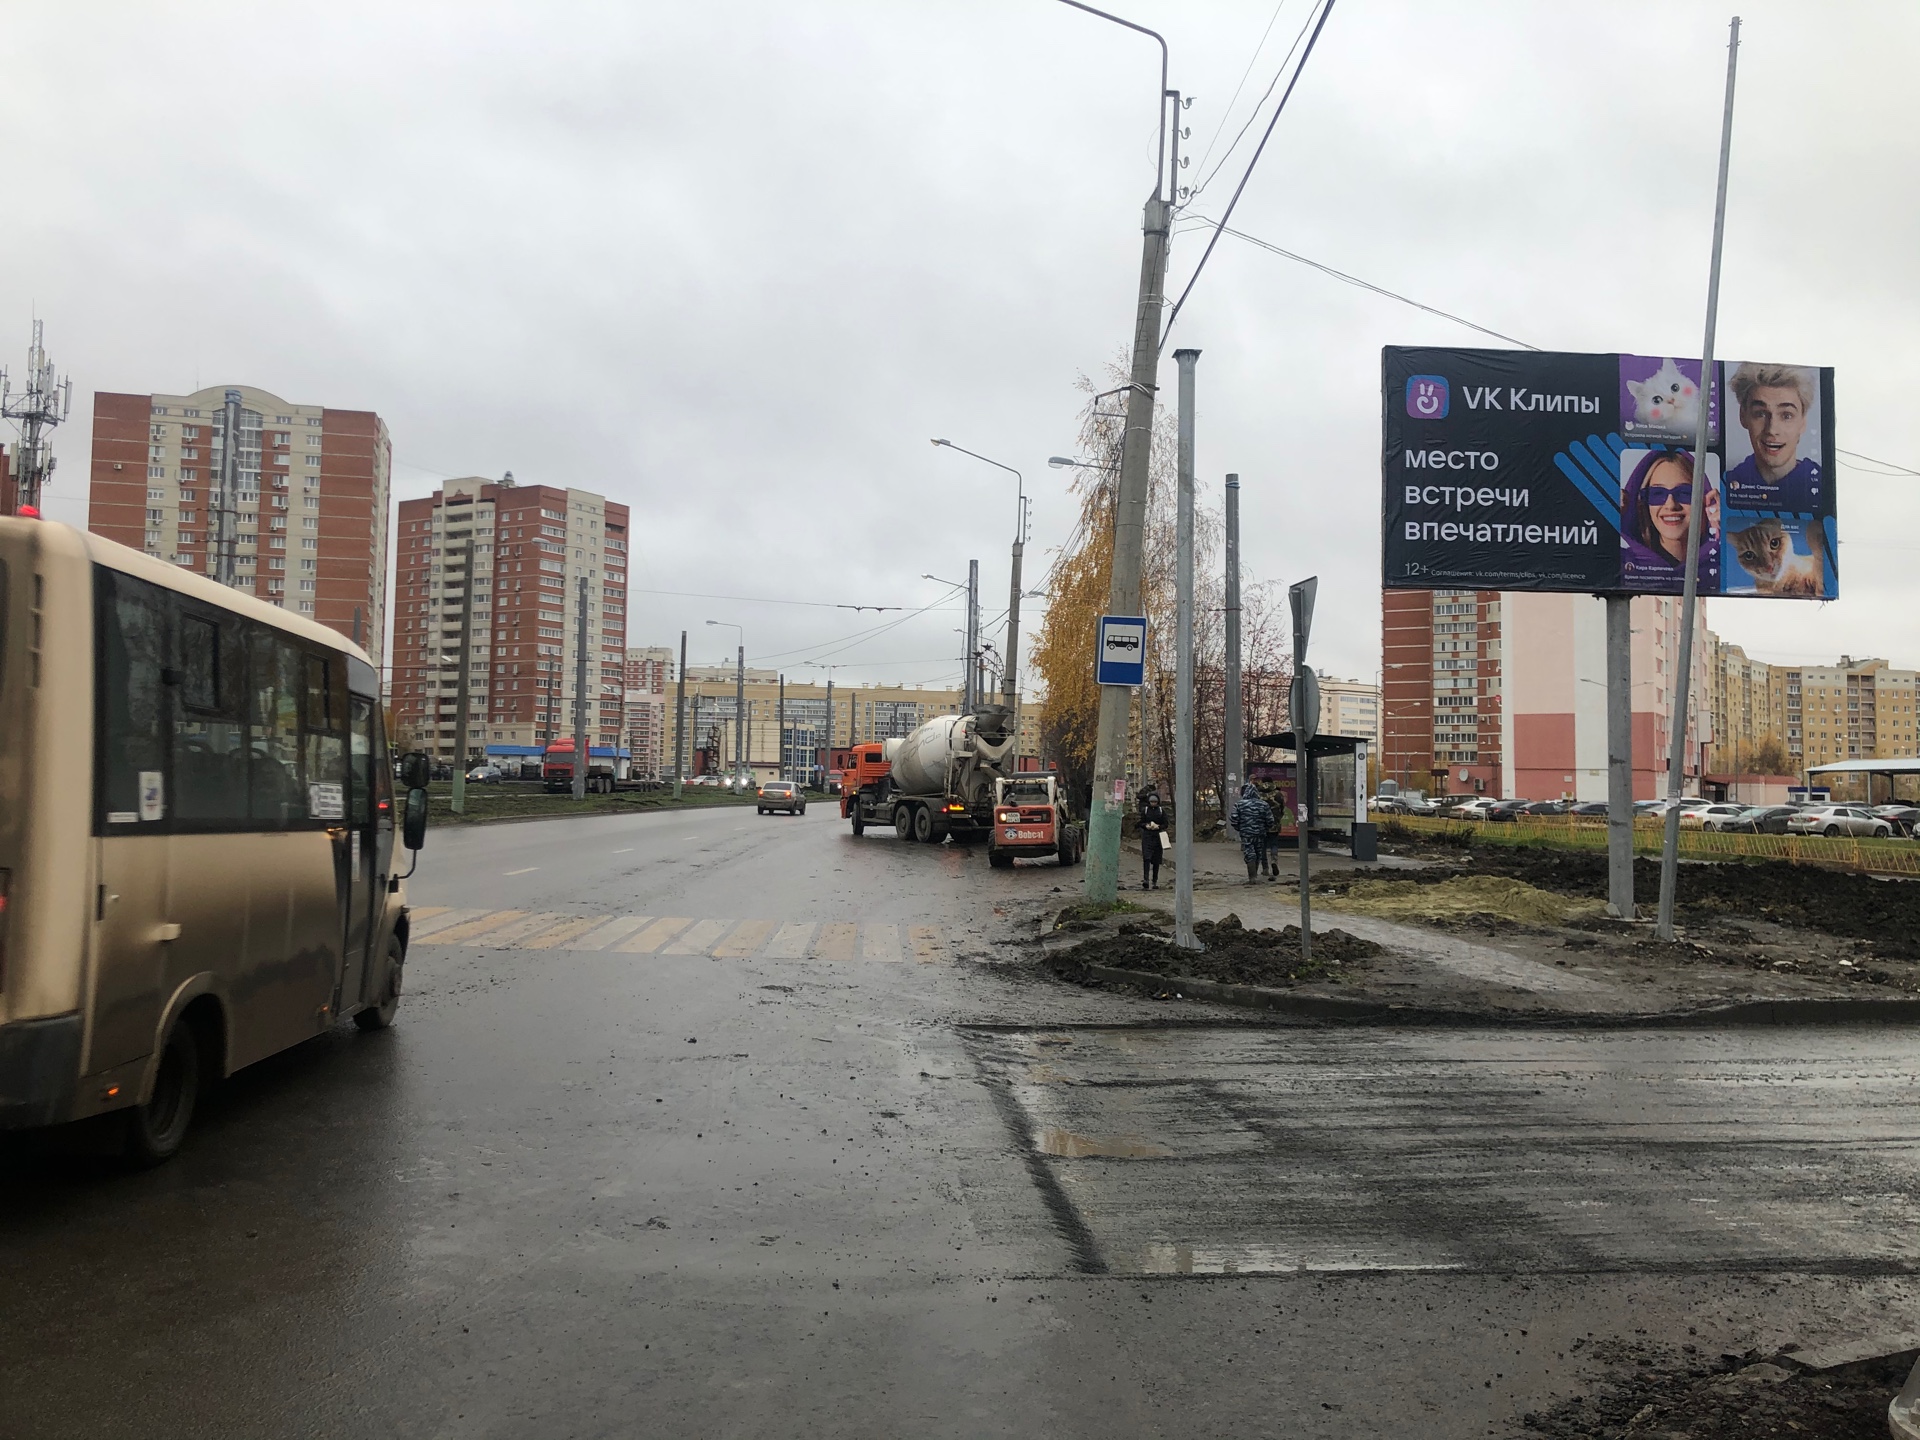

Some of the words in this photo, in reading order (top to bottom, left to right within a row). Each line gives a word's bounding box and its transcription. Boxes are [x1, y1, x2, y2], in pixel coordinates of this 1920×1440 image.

[1462, 386, 1503, 411] VK
[1510, 388, 1600, 414] Клипы
[1405, 449, 1499, 471] место
[1405, 485, 1529, 512] встречи
[1405, 519, 1598, 545] впечатлений
[1405, 562, 1429, 576] 12+
[1018, 831, 1044, 839] Bobcat
